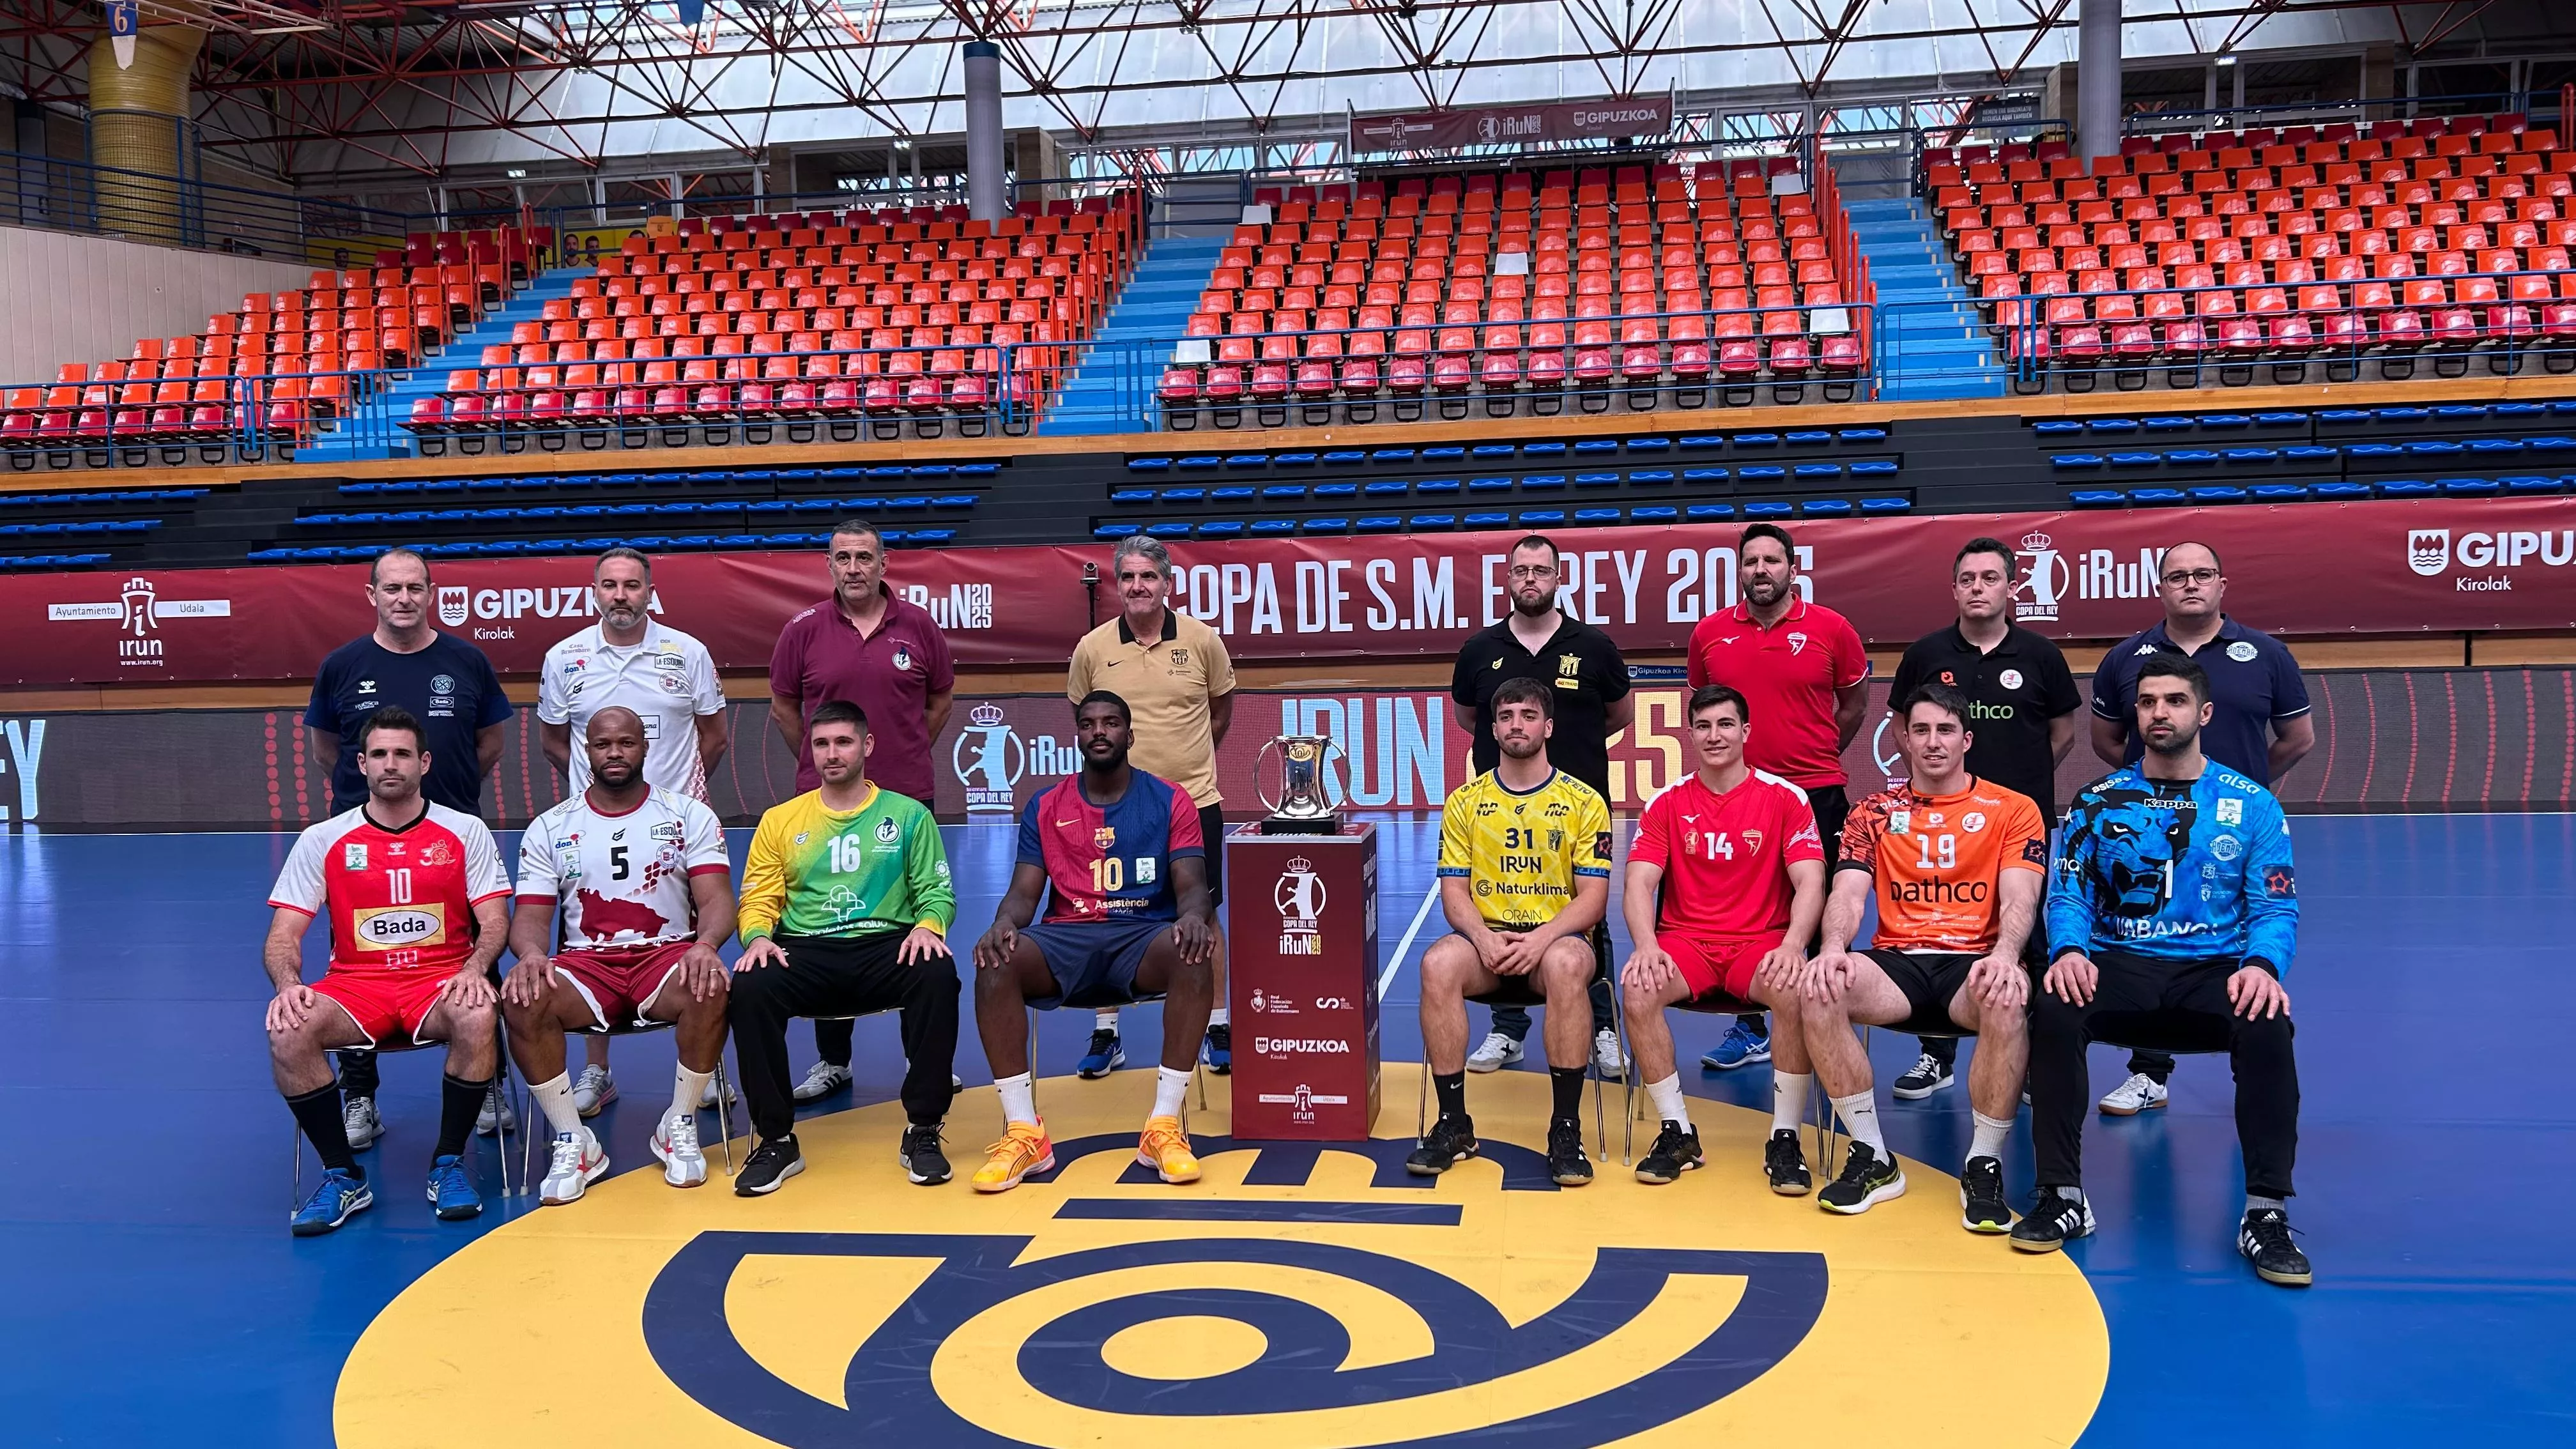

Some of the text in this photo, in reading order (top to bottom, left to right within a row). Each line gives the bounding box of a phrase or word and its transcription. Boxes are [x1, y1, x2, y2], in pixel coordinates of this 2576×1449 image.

[114, 4, 128, 33] 6
[1503, 115, 1532, 135] iRuN
[1587, 109, 1658, 123] GIPUZKOA
[2457, 530, 2576, 567] GIPU
[1296, 560, 1353, 633] DE
[1366, 556, 1468, 631] S.M.
[1667, 546, 1813, 623] 205
[2457, 575, 2512, 591] Kirolak
[56, 606, 116, 617] Ayuntamiento
[180, 603, 204, 613] Udala
[474, 586, 664, 619] GIPUZA
[2016, 605, 2058, 616] COPA DEL REY
[474, 626, 515, 640] Kirolak
[119, 639, 163, 656] irun
[1968, 700, 2014, 719] thco
[2218, 774, 2260, 794] alsa
[967, 792, 1013, 803] COPA DEL REY
[1880, 799, 1908, 810] alsa
[2144, 799, 2198, 809] Kappa
[1505, 828, 1533, 849] 31
[1704, 832, 1733, 860] 14
[827, 834, 861, 874] 16
[1916, 834, 1956, 869] 19
[611, 846, 629, 880] 5
[1089, 857, 1123, 892] 10
[2164, 859, 2174, 898] 1
[386, 868, 412, 905] 10
[1496, 882, 1569, 895] Naturklima
[1094, 898, 1149, 910] Assistència
[1503, 909, 1542, 921] ORAIN
[374, 917, 425, 935] Bada
[1279, 934, 1312, 955] iRuN
[1270, 1039, 1349, 1053] GIPUZKOA
[1293, 1112, 1314, 1120] irun
